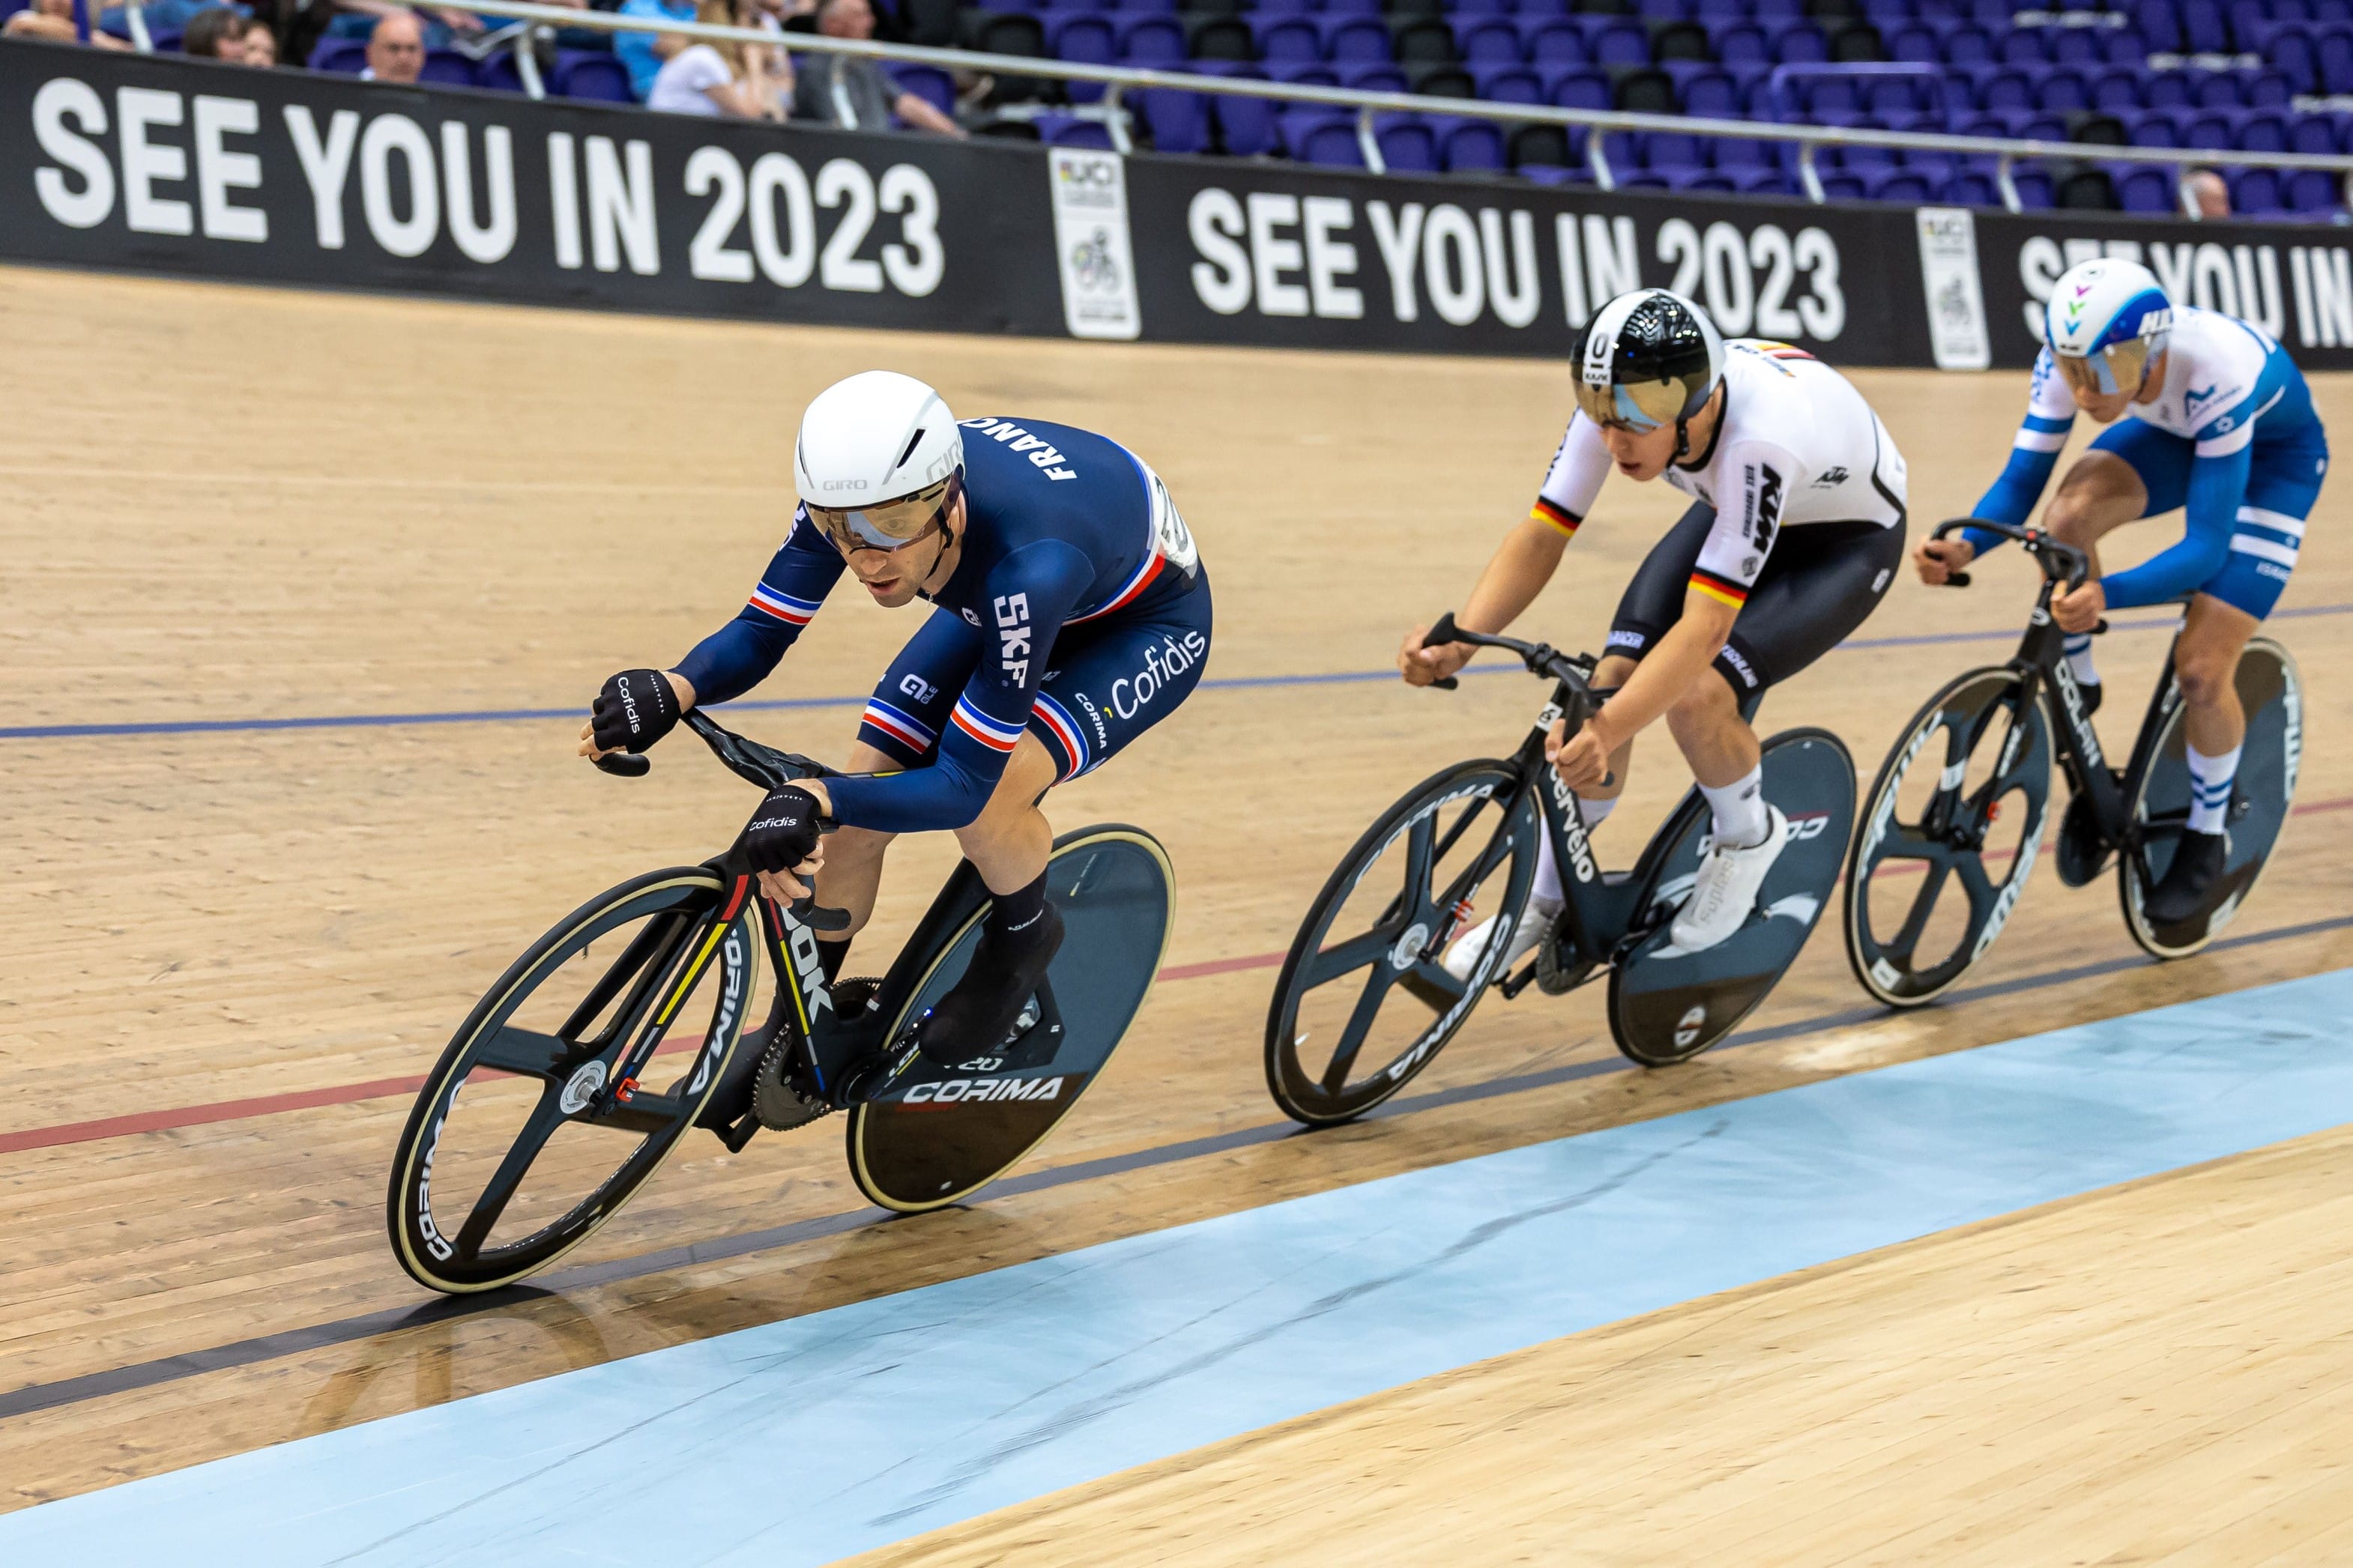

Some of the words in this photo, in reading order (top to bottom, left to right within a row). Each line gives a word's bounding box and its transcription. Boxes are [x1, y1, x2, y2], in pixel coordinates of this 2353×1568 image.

[32, 77, 268, 243] SEE
[283, 104, 518, 264] YOU
[548, 132, 660, 276] IN
[684, 146, 944, 297] 2023
[1188, 188, 1365, 319] SEE
[1367, 200, 1540, 327] YOU
[1556, 212, 1640, 330] IN
[1658, 218, 1846, 342] 2023
[2148, 242, 2286, 340] YOU
[2290, 246, 2352, 348] IN
[822, 479, 868, 491] GIRO
[925, 434, 963, 483] GIR
[957, 417, 1077, 480] FRANC
[1754, 462, 1783, 554] KTM
[994, 593, 1030, 688] SKF
[1111, 630, 1206, 719] Cofidis
[617, 676, 640, 733] Cofidis
[1075, 692, 1107, 749] CORIMA
[749, 817, 797, 832] Cofidis
[781, 906, 833, 1025] OK
[687, 928, 742, 1095] ORIMA
[903, 1077, 1064, 1104] CORIMA
